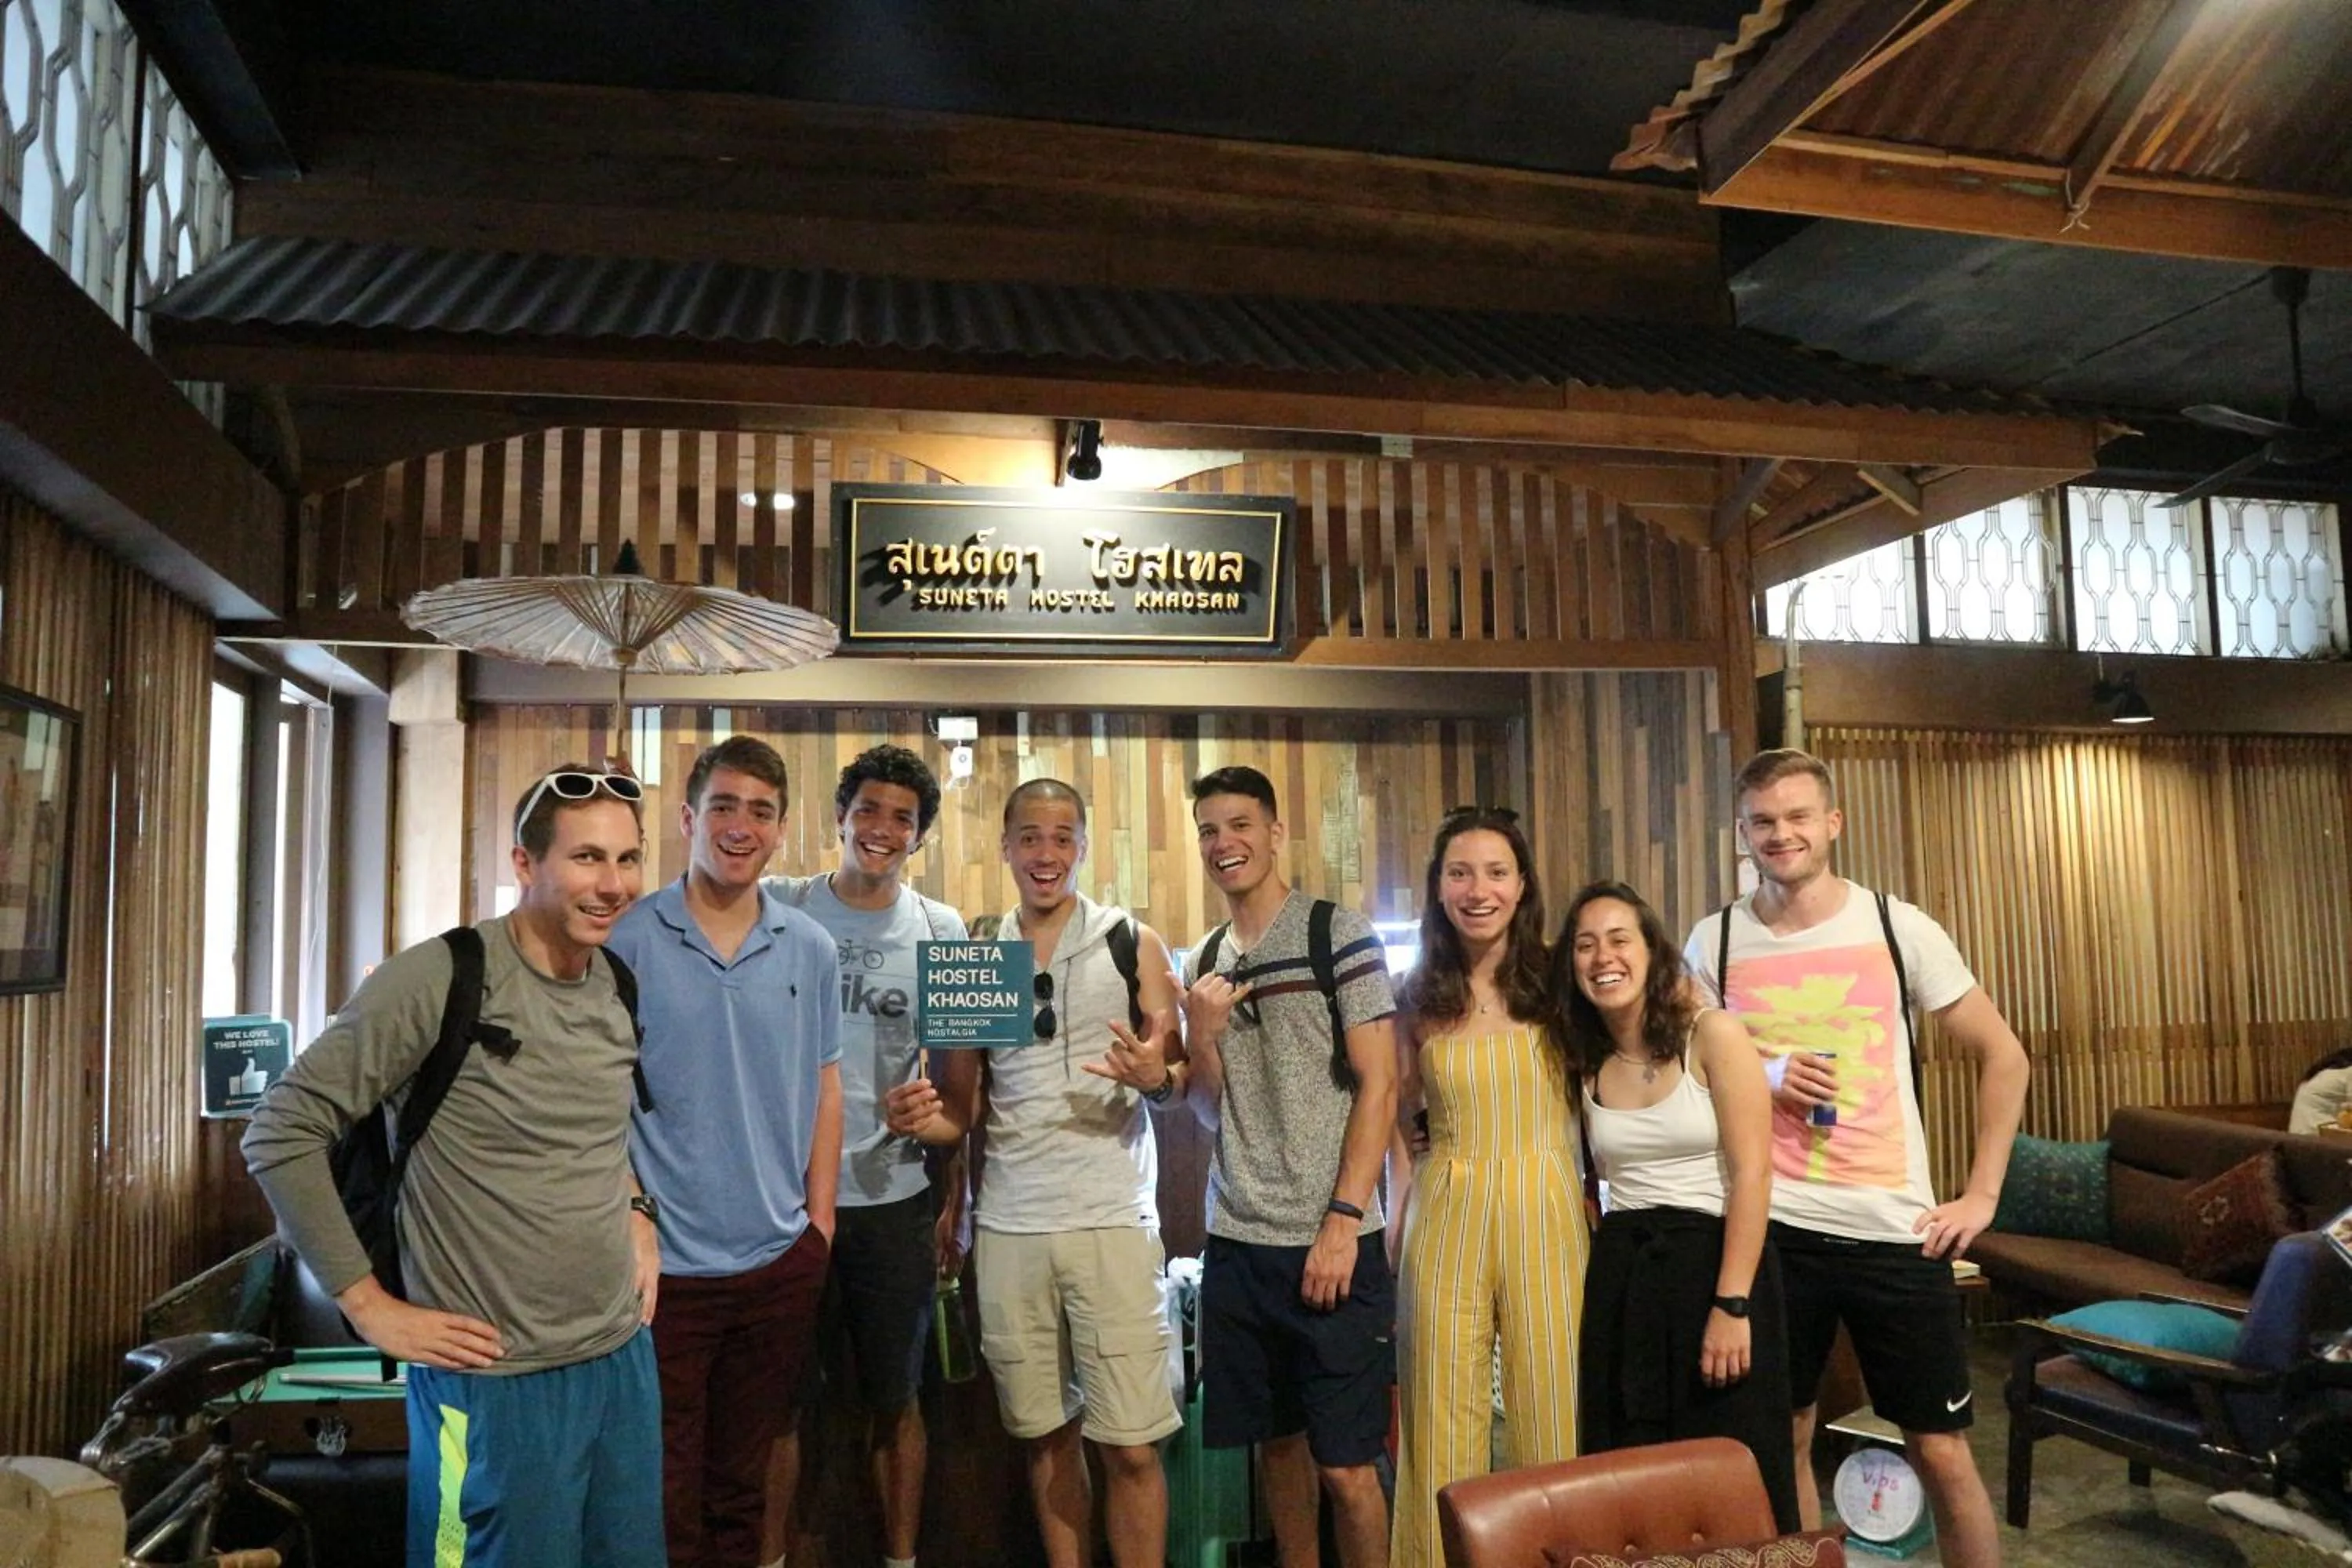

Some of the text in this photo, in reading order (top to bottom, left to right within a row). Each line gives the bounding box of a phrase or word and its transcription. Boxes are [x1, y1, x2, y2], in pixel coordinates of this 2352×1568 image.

[1082, 528, 1243, 583] โฮสเทล
[919, 587, 1240, 609] SUNETA HOSTEL KHAOSAN
[928, 946, 1004, 962] SUNETA
[928, 968, 1004, 985] HOSTEL
[840, 973, 909, 1018] ike
[927, 992, 1018, 1007] KHAOSAN
[224, 1029, 270, 1040] WE LOVE
[213, 1040, 236, 1050] THIS
